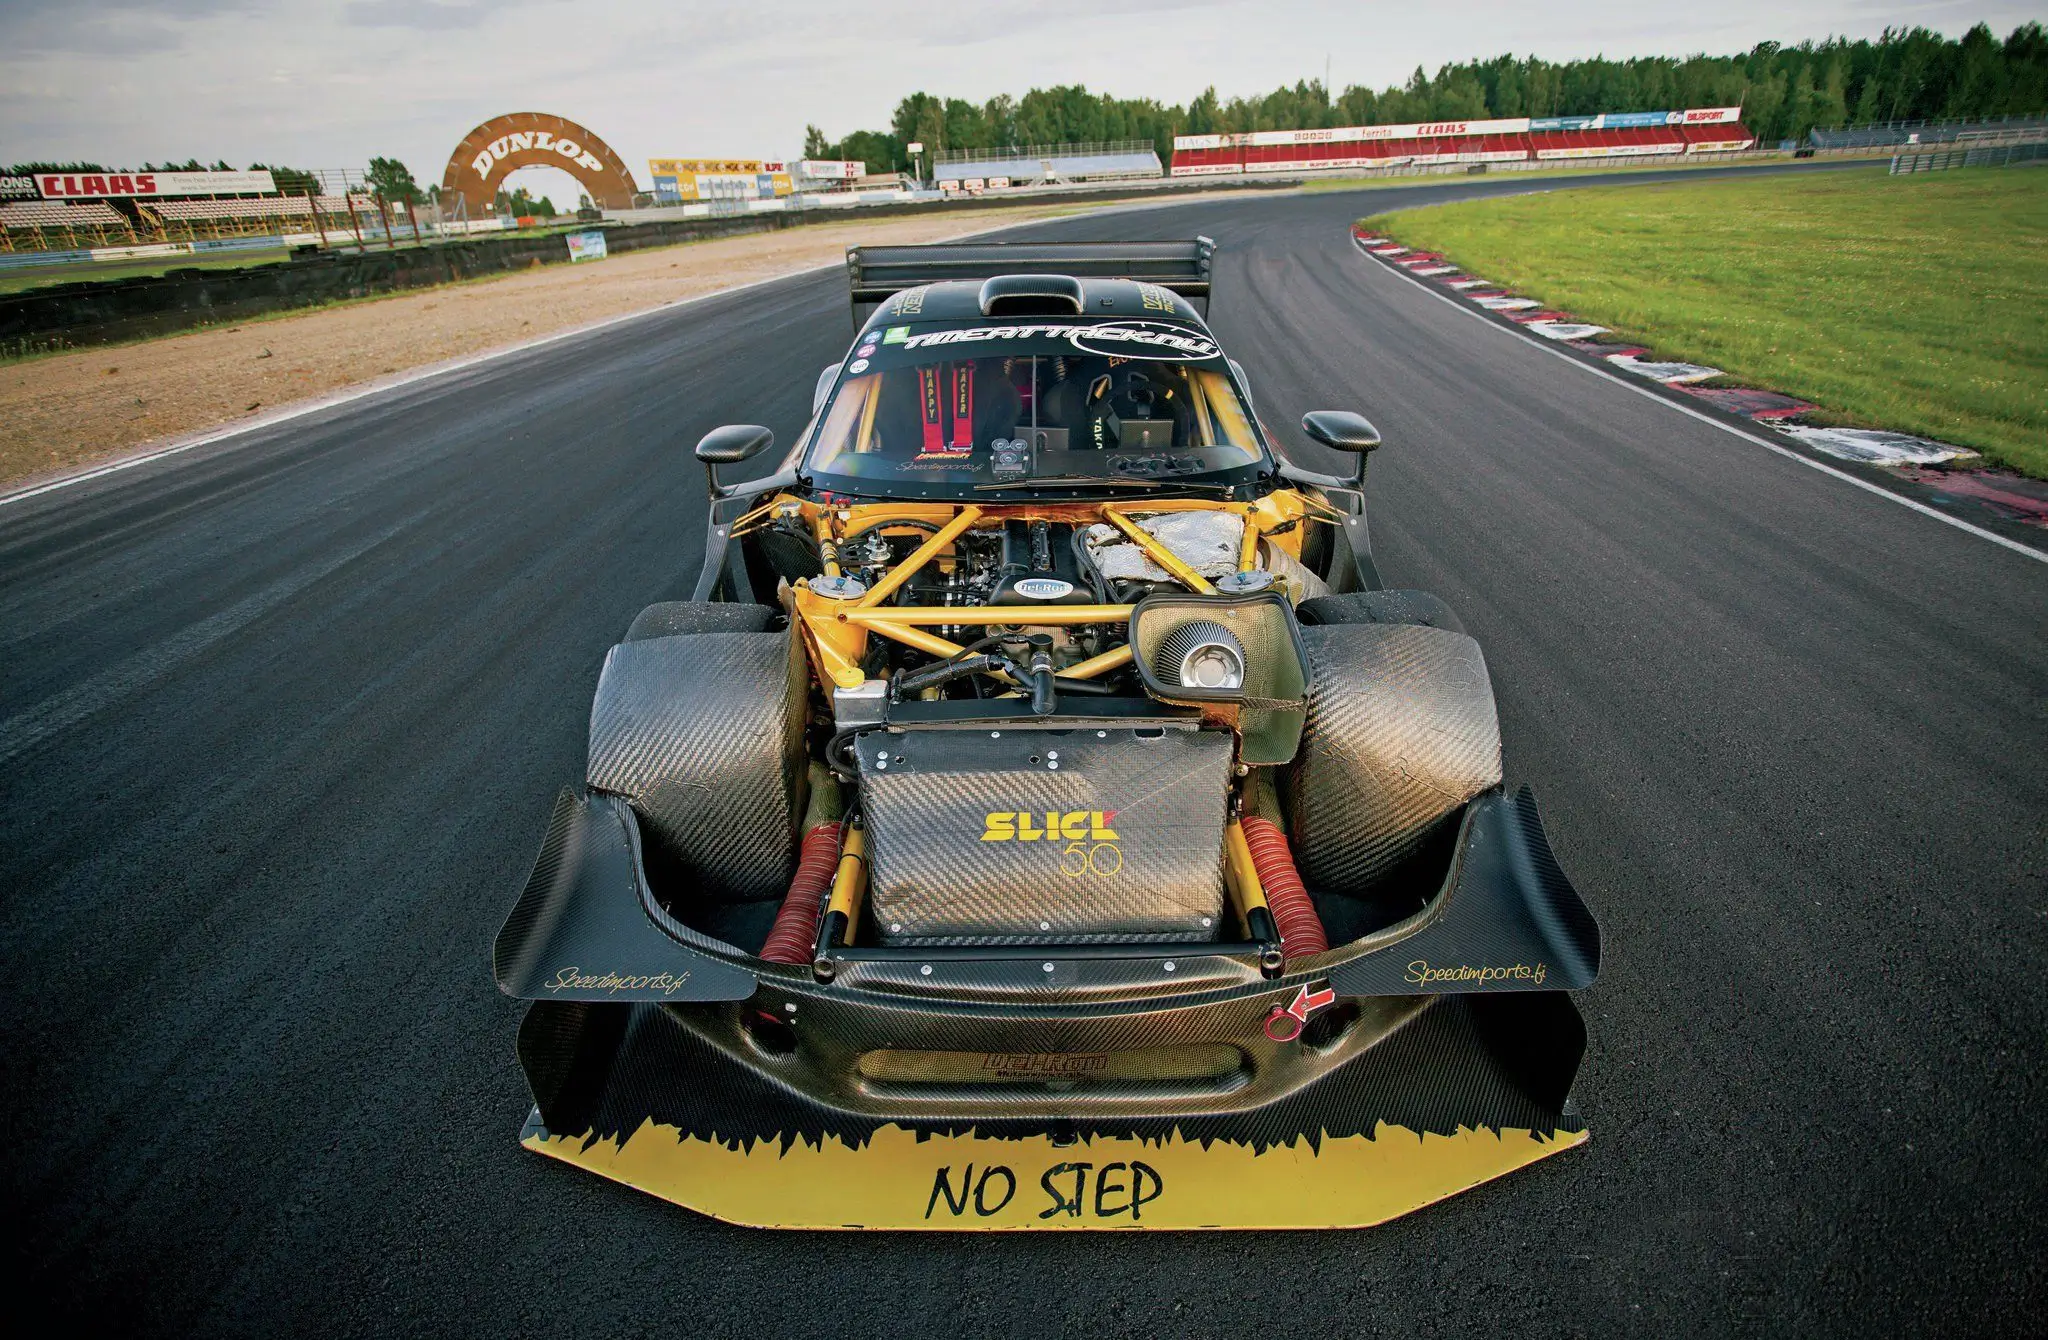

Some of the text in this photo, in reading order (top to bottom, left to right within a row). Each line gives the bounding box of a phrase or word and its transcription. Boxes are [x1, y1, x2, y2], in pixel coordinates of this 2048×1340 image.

[1417, 124, 1466, 135] CLAAS
[472, 132, 603, 180] DUNLOP
[43, 175, 156, 196] CLAAS
[925, 368, 935, 418] HAPPY
[1060, 842, 1122, 877] 50
[544, 966, 692, 995] Speedimports.fi
[1403, 960, 1547, 988] Speedimports.fi
[925, 1160, 1163, 1220] NO STEP
